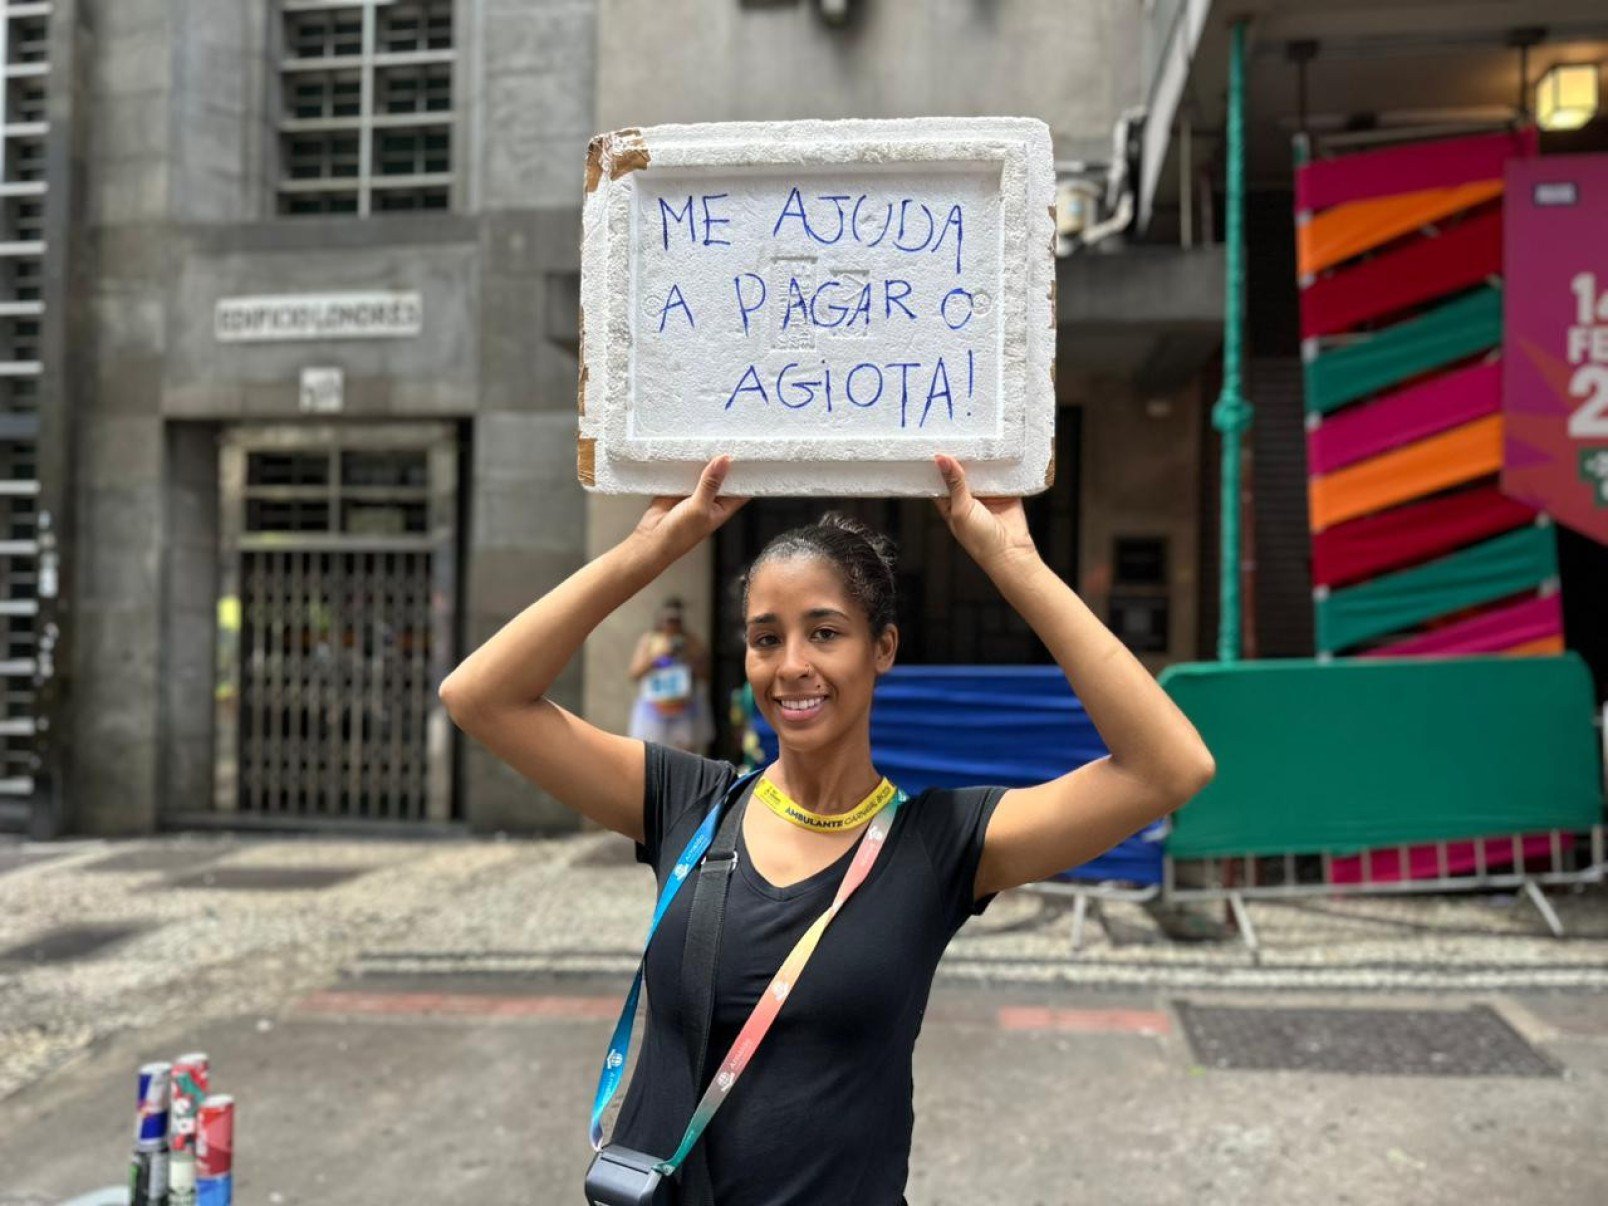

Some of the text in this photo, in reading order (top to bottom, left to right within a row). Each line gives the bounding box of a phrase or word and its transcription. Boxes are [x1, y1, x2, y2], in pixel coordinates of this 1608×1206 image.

[658, 187, 963, 275] ME AJUDA
[659, 273, 974, 337] A PAGAR O
[785, 806, 844, 828] AMBULANTE
